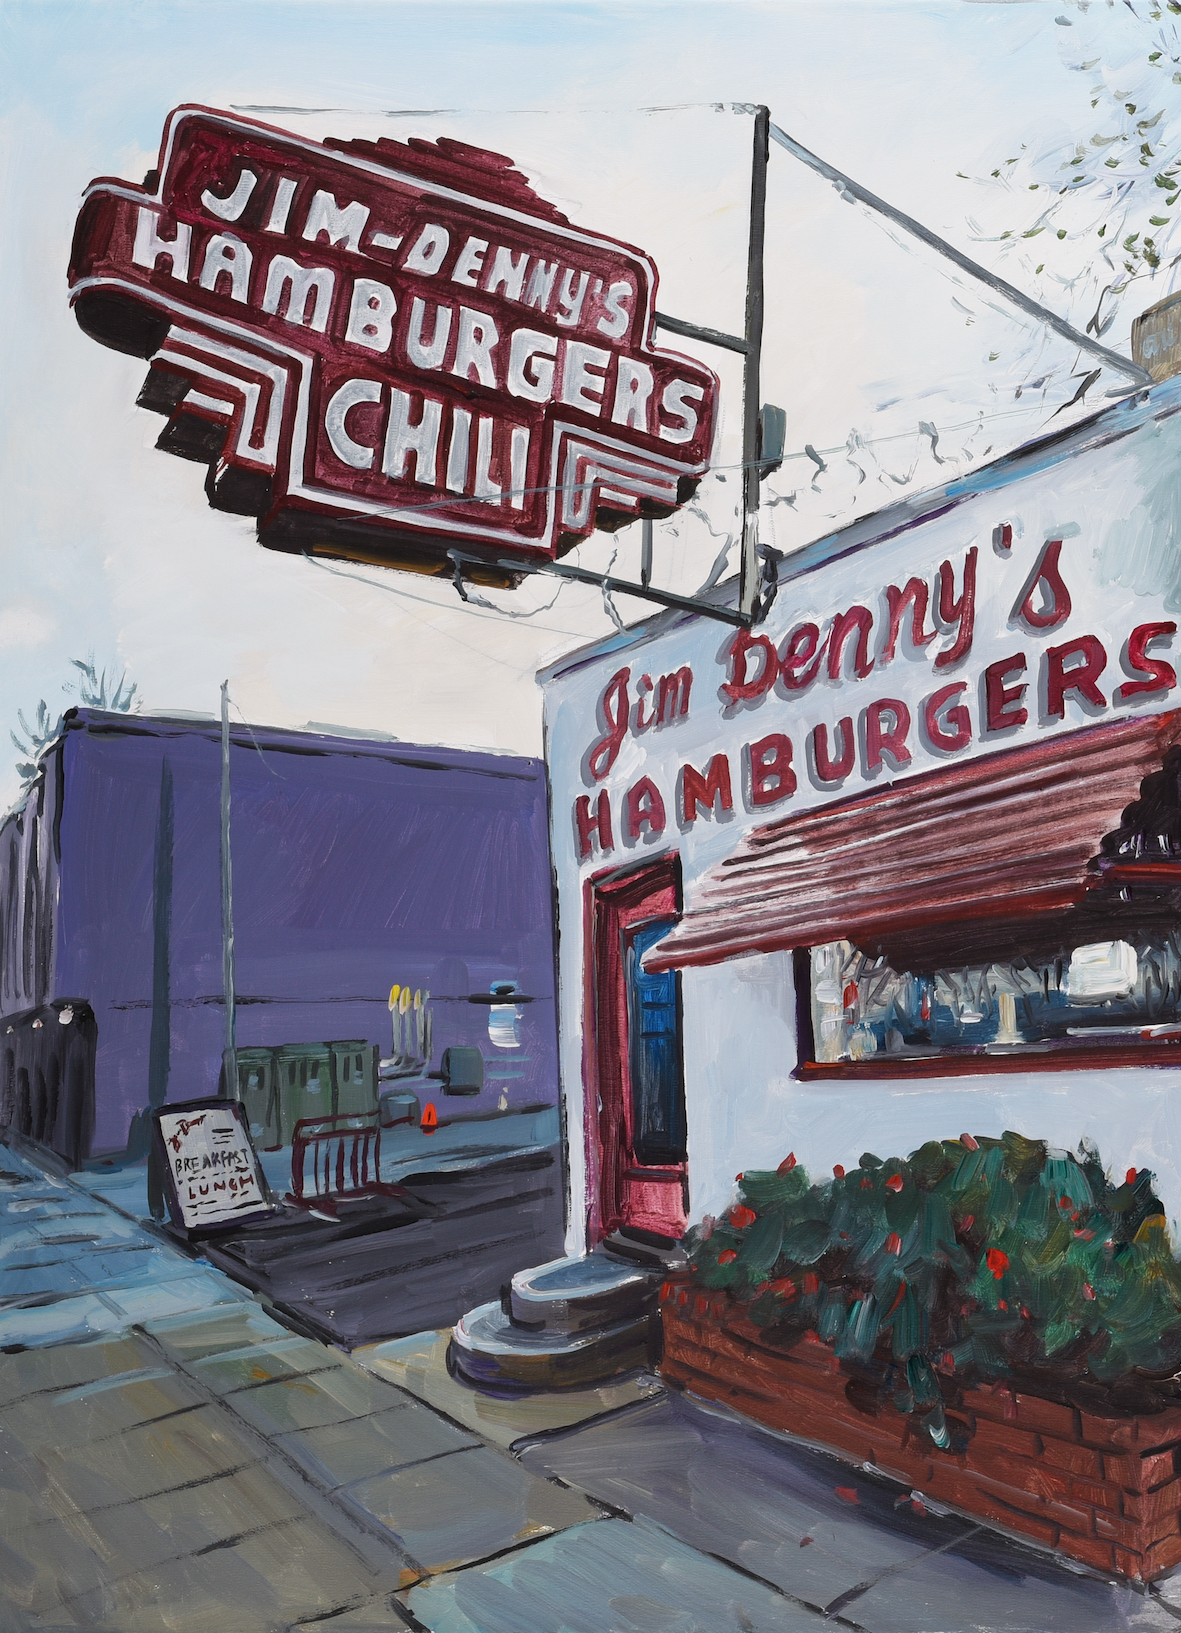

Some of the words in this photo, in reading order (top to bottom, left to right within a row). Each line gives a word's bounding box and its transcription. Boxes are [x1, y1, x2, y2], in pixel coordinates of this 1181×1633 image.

[132, 207, 704, 443] HAMBURGERS
[201, 169, 632, 338] JIM-DENNY'S
[324, 378, 530, 511] CHILI
[574, 621, 1178, 859] HAMBURGERS
[588, 666, 694, 783] Jim
[720, 522, 1073, 706] Denny's
[188, 1174, 254, 1200] LUNCH
